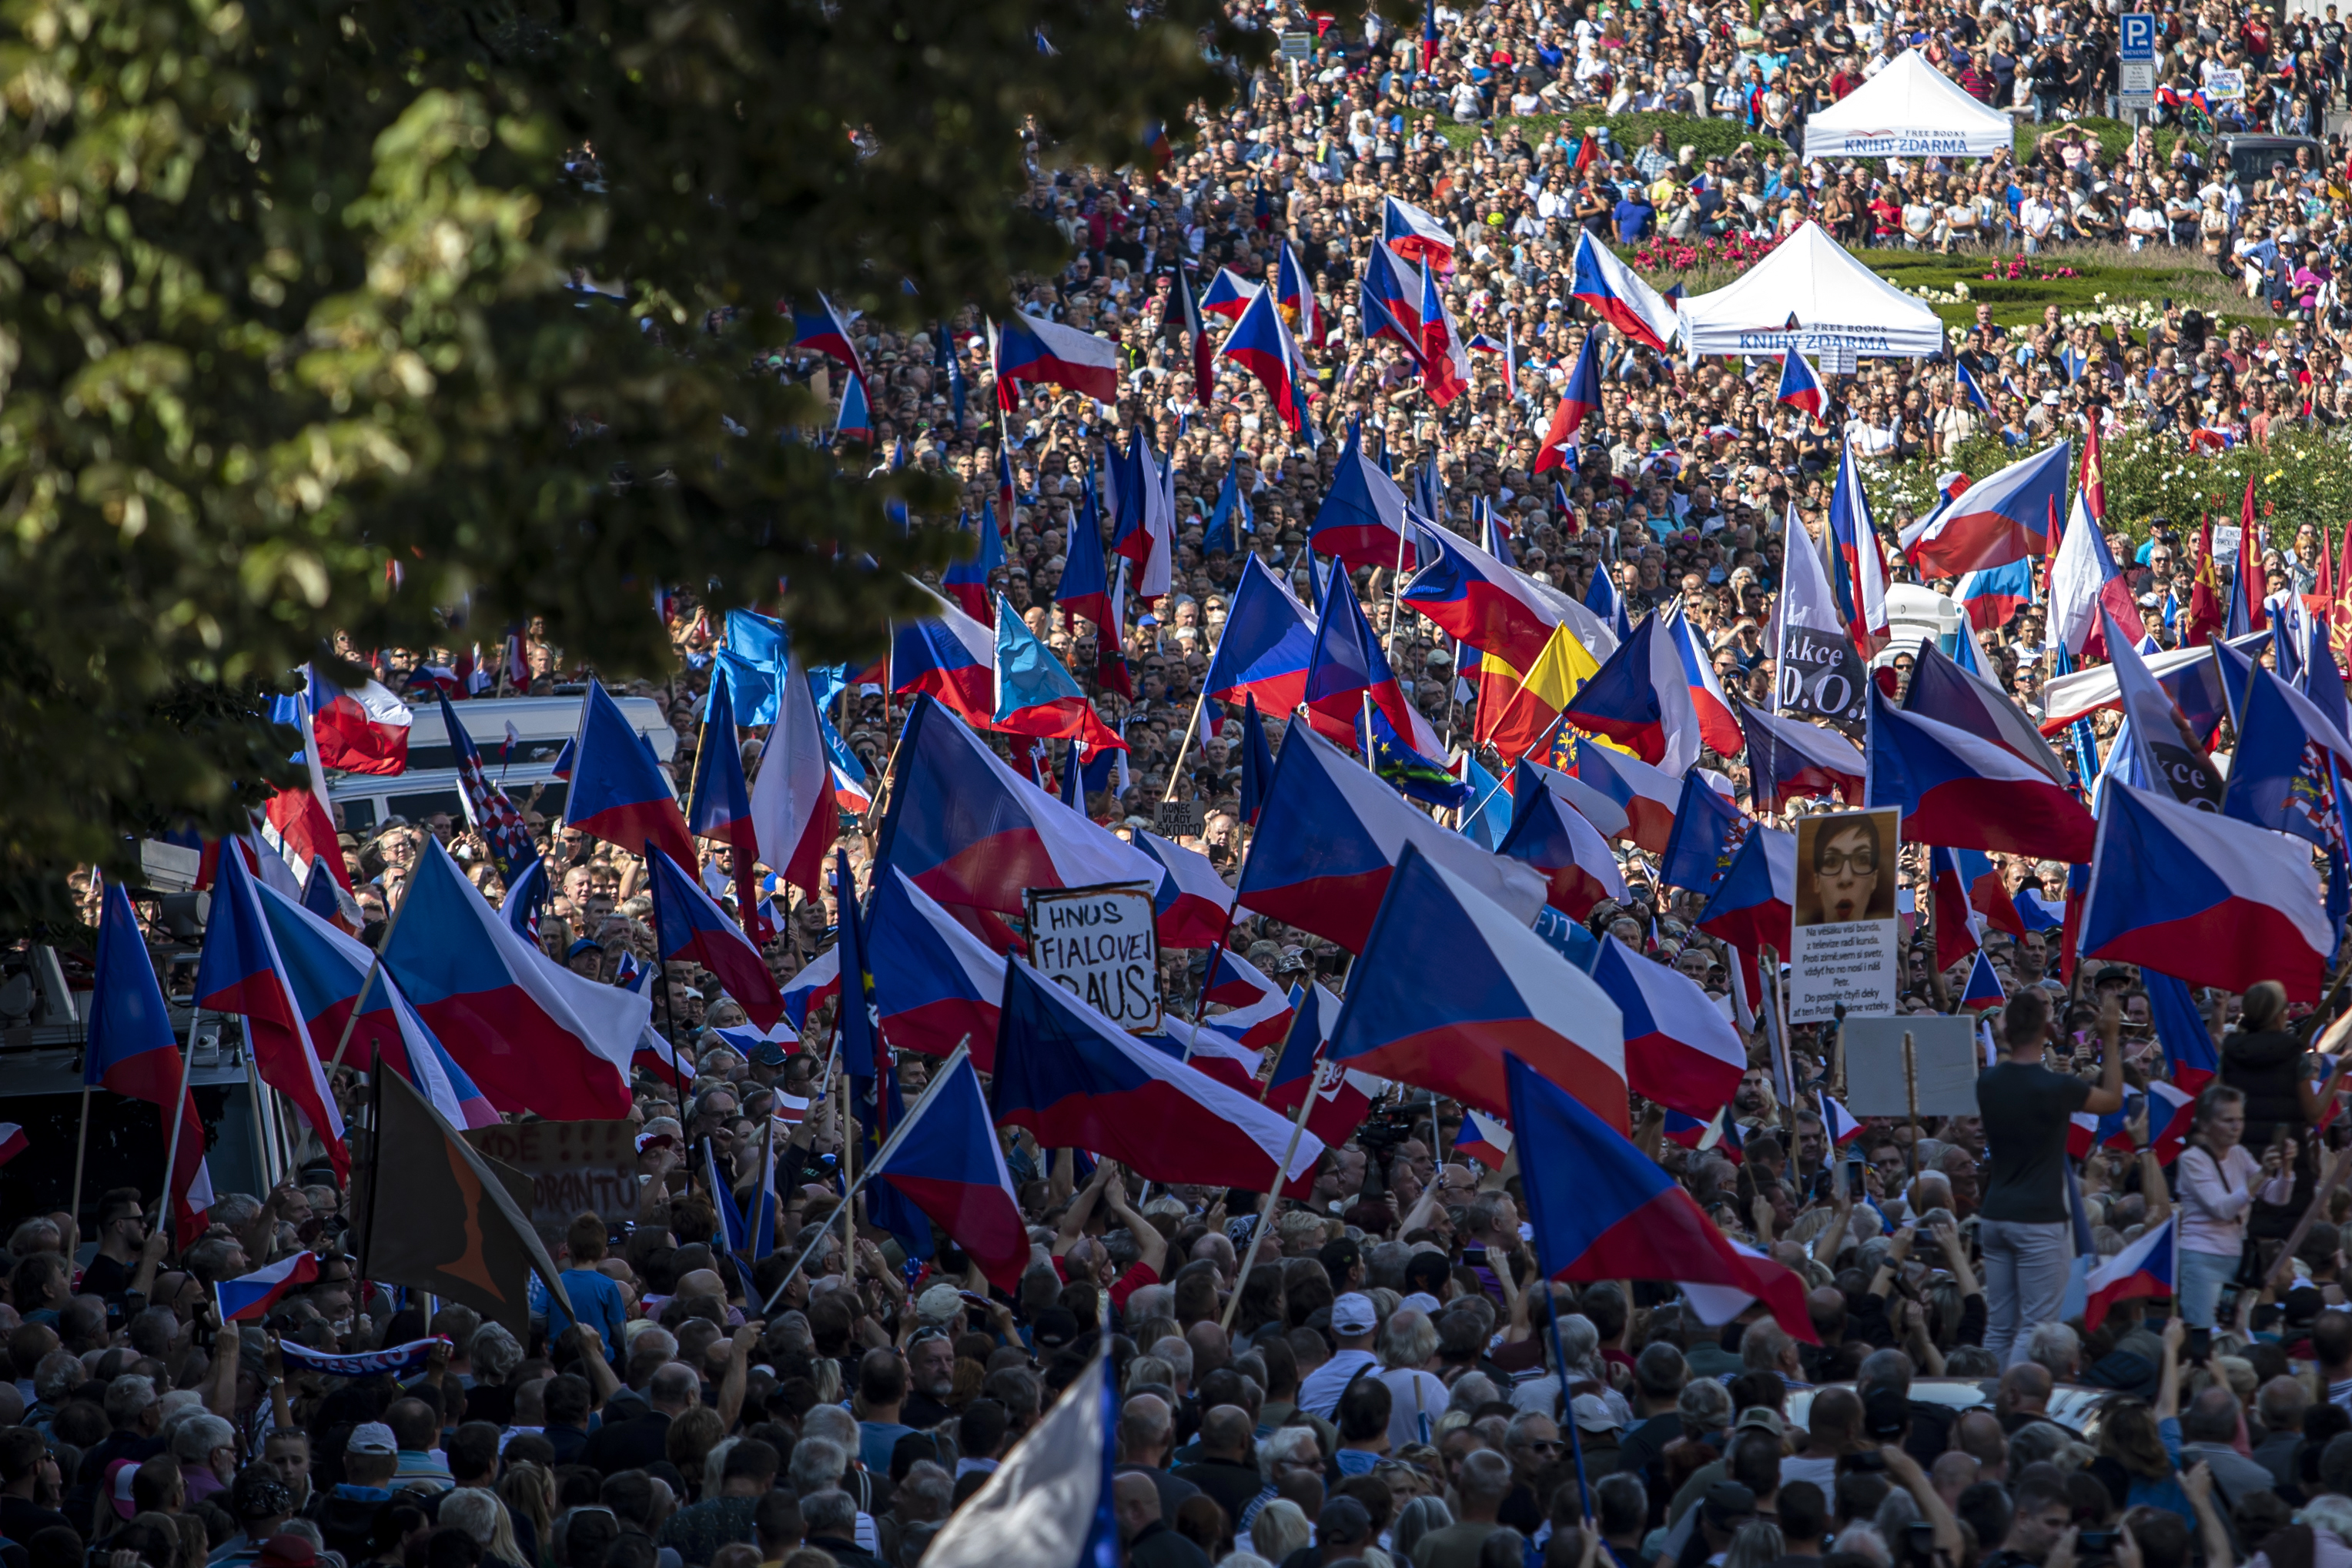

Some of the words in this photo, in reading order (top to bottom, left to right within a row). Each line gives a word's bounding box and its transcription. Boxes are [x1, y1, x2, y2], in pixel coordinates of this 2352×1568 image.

[2127, 19, 2147, 47] P
[1845, 139, 1895, 152] KNIHY
[1899, 139, 1969, 152] ZDARMA
[1814, 323, 1843, 332] FREE
[1739, 334, 1801, 349] KNIHY
[1806, 335, 1889, 350] ZDARMA
[1785, 634, 1843, 667] Akce
[1783, 665, 1867, 720] D.O.
[1162, 803, 1190, 814] KONEC
[1049, 901, 1123, 931] HNUS
[1806, 928, 1816, 937] Na
[1040, 929, 1151, 969] FIALOVEJ
[1812, 939, 1839, 949] televize
[1802, 954, 1819, 964] Proti
[1825, 965, 1835, 975] ho
[1833, 978, 1849, 987] Petr.
[1805, 994, 1815, 1003] Do
[1817, 991, 1843, 1003] postele
[1844, 989, 1860, 1001] čtyři
[1861, 988, 1879, 999] deky
[1815, 1006, 1834, 1015] Putin
[1865, 1002, 1890, 1013] vzteky.
